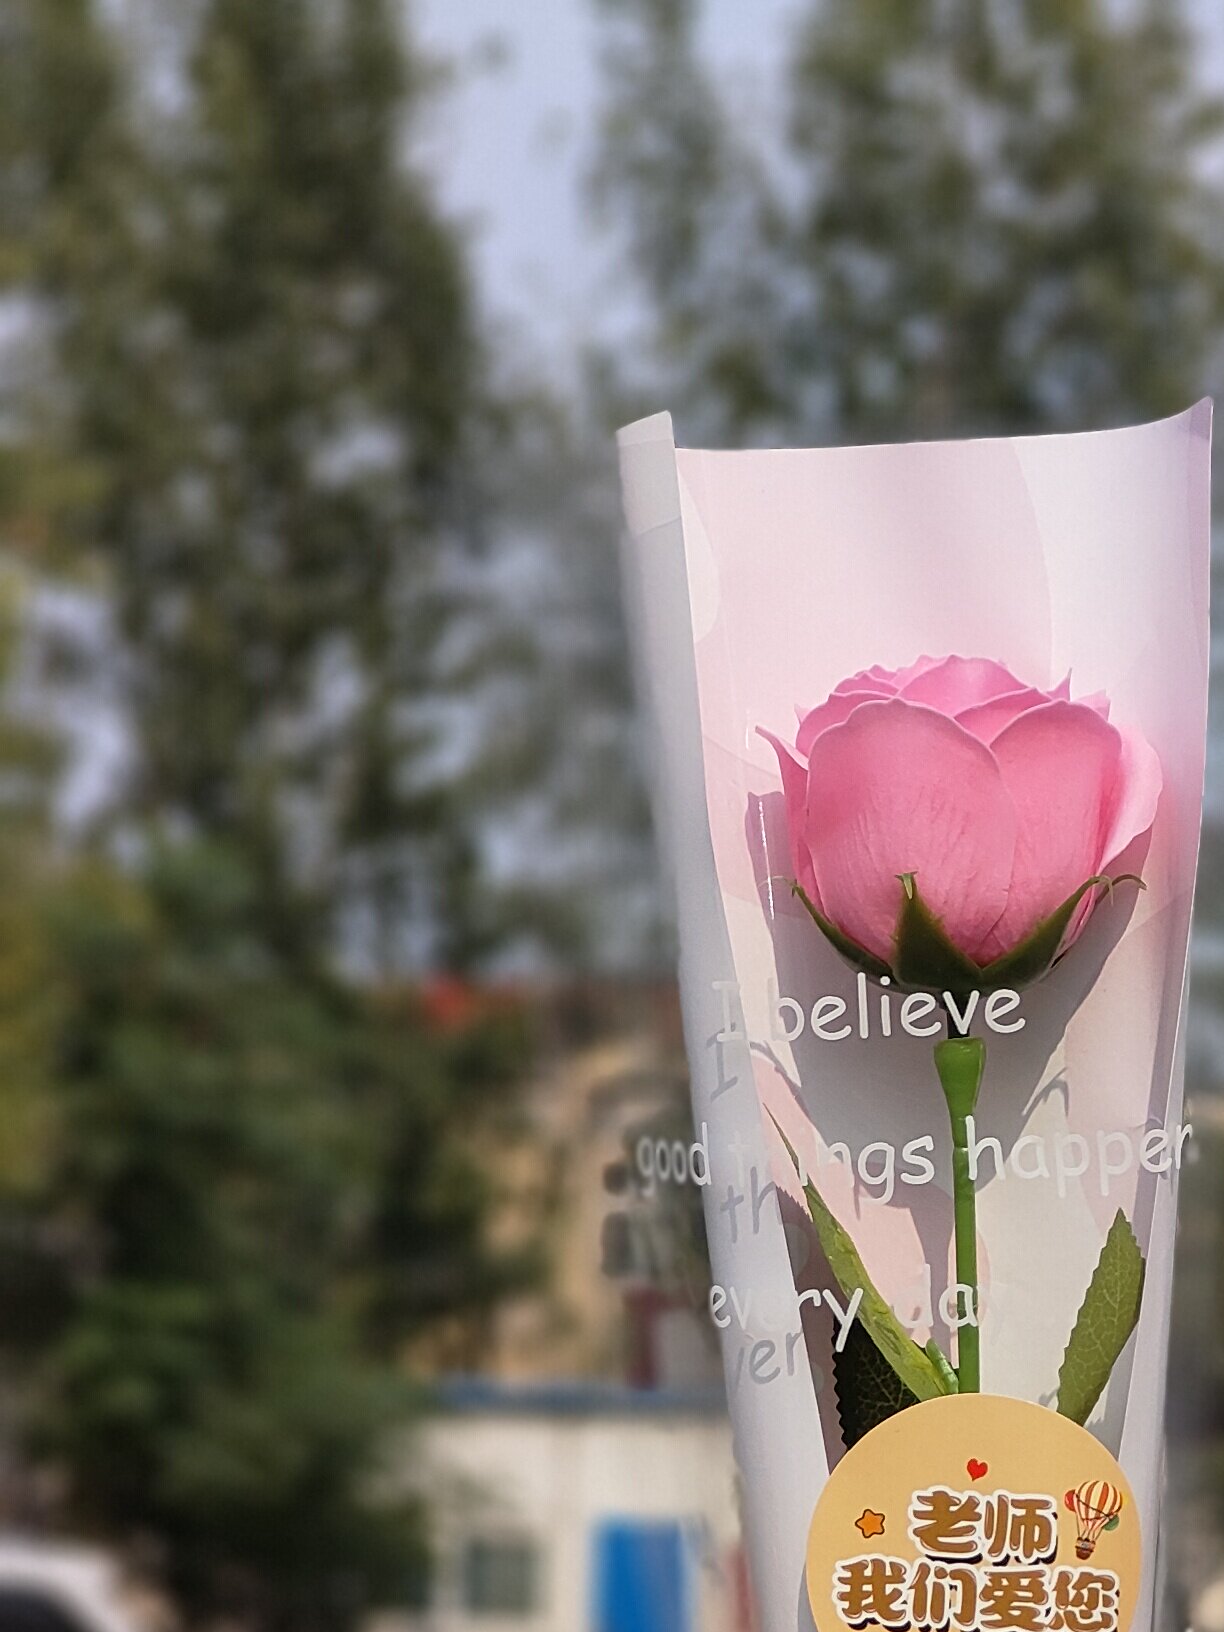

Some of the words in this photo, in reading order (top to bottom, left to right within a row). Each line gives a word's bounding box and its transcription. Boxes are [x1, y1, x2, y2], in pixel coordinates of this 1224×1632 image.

[711, 980, 746, 1042] I
[768, 971, 1027, 1043] believe
[636, 1121, 713, 1198] good
[727, 1127, 936, 1206] tings
[893, 1263, 988, 1329] da
[907, 1485, 1059, 1566] 老师
